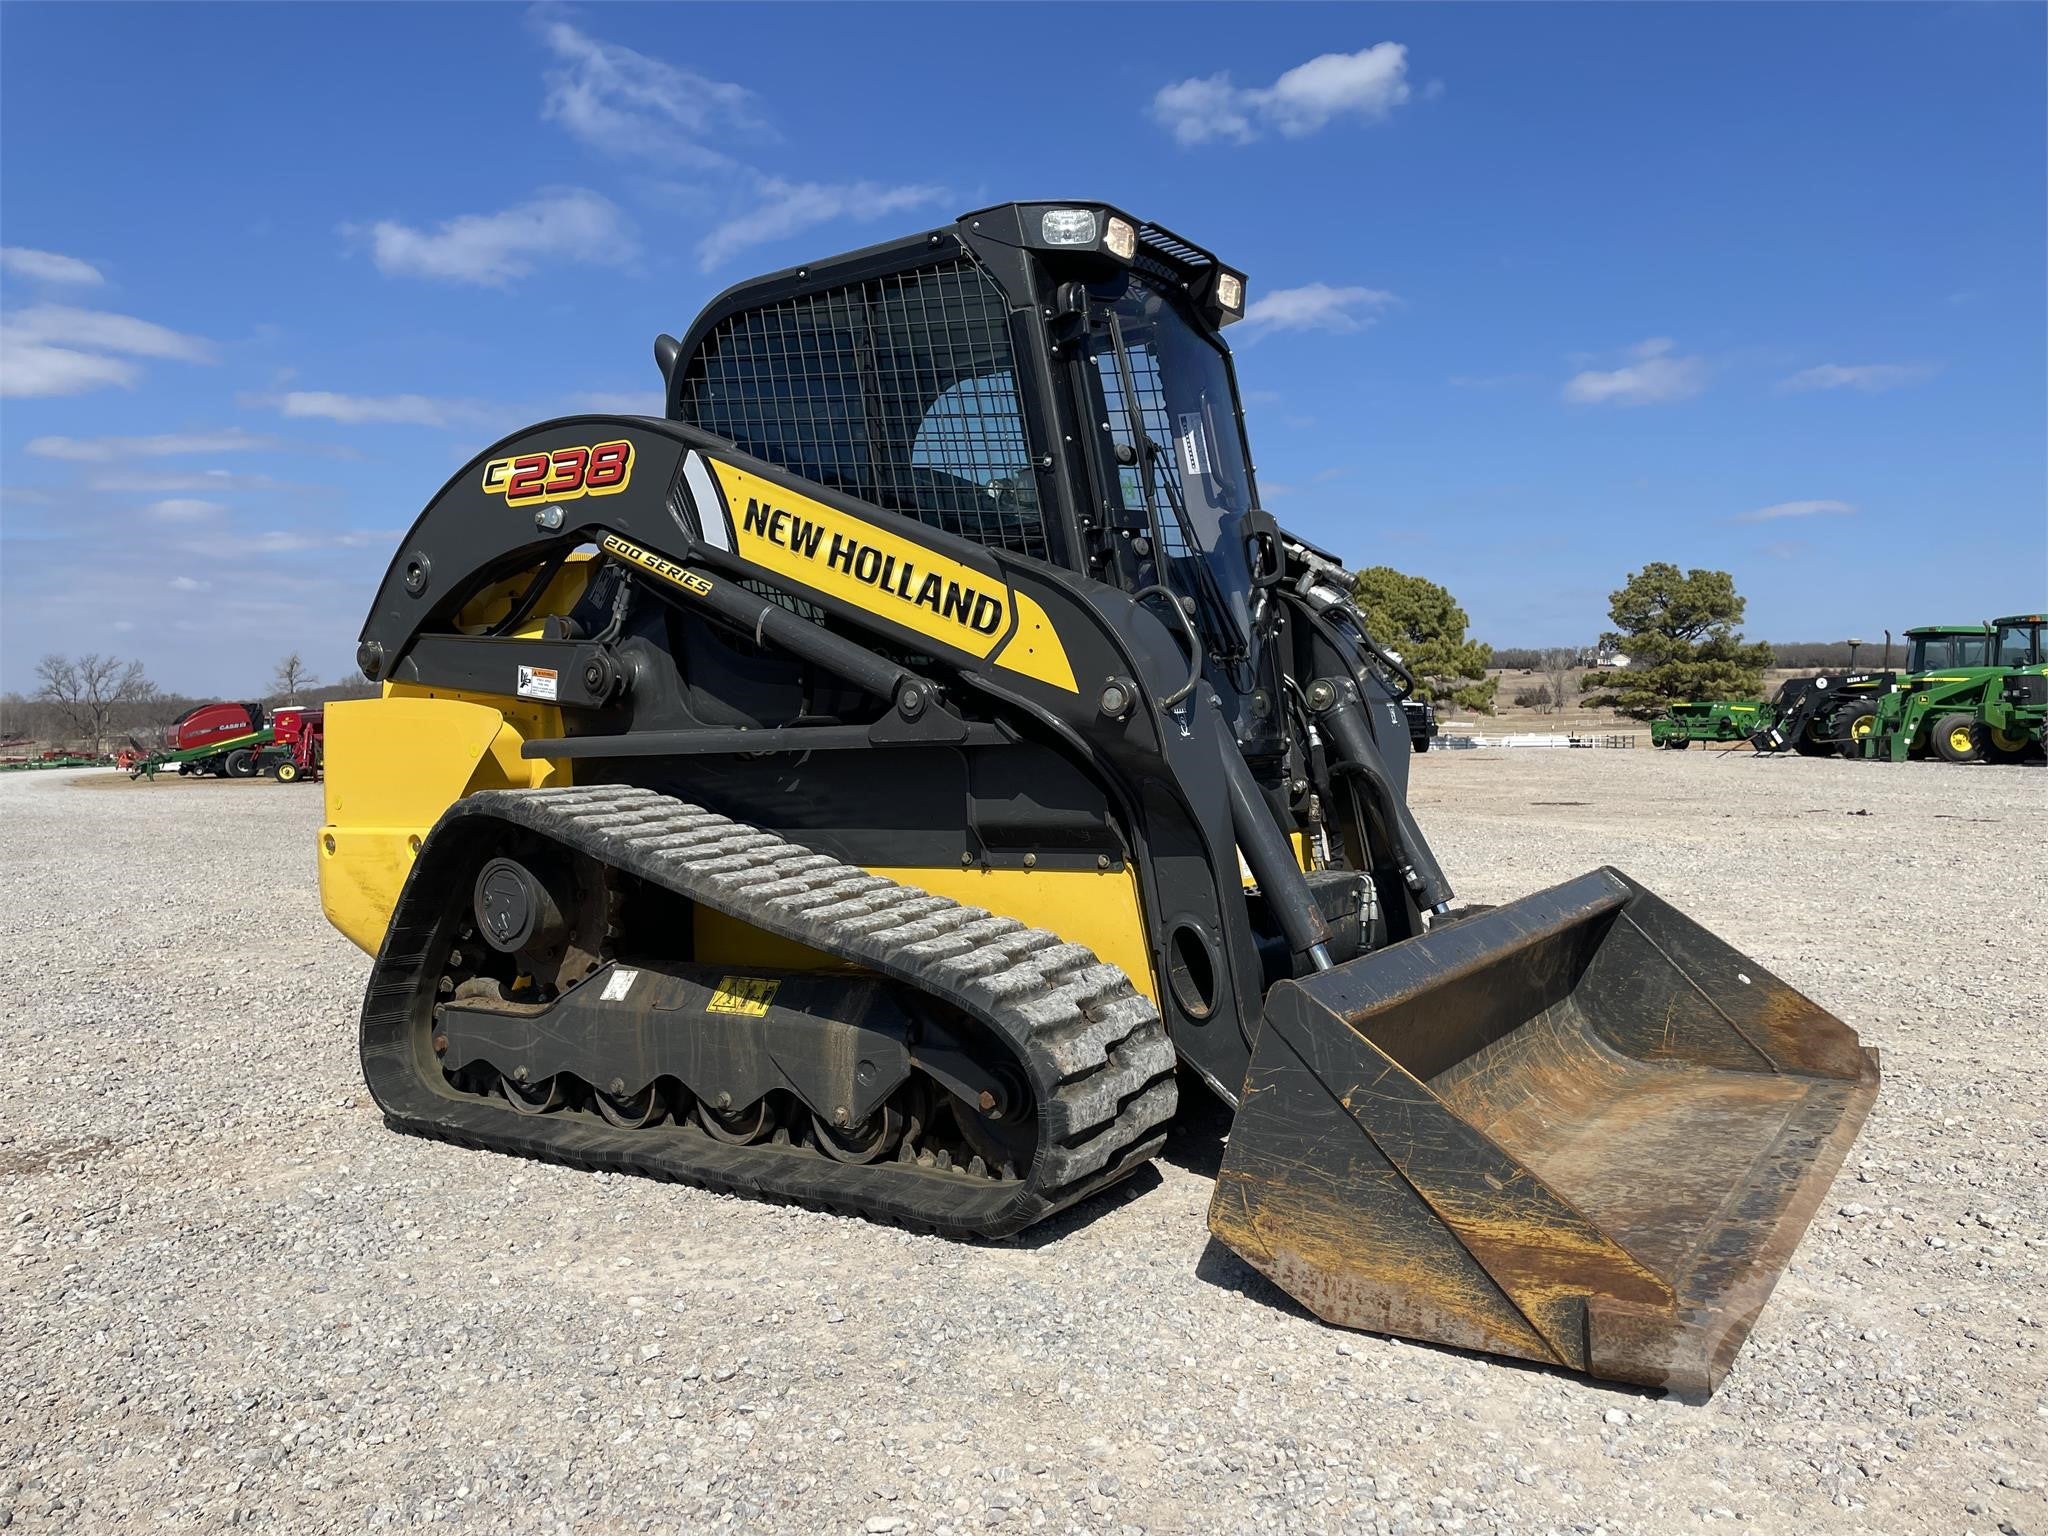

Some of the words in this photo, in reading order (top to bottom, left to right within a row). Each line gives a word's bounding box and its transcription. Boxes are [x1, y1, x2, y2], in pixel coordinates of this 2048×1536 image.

[484, 442, 632, 501] C238
[605, 536, 642, 560] 200
[643, 555, 712, 593] SERIES
[743, 497, 825, 560] NEW
[827, 532, 1002, 636] HOLLAND
